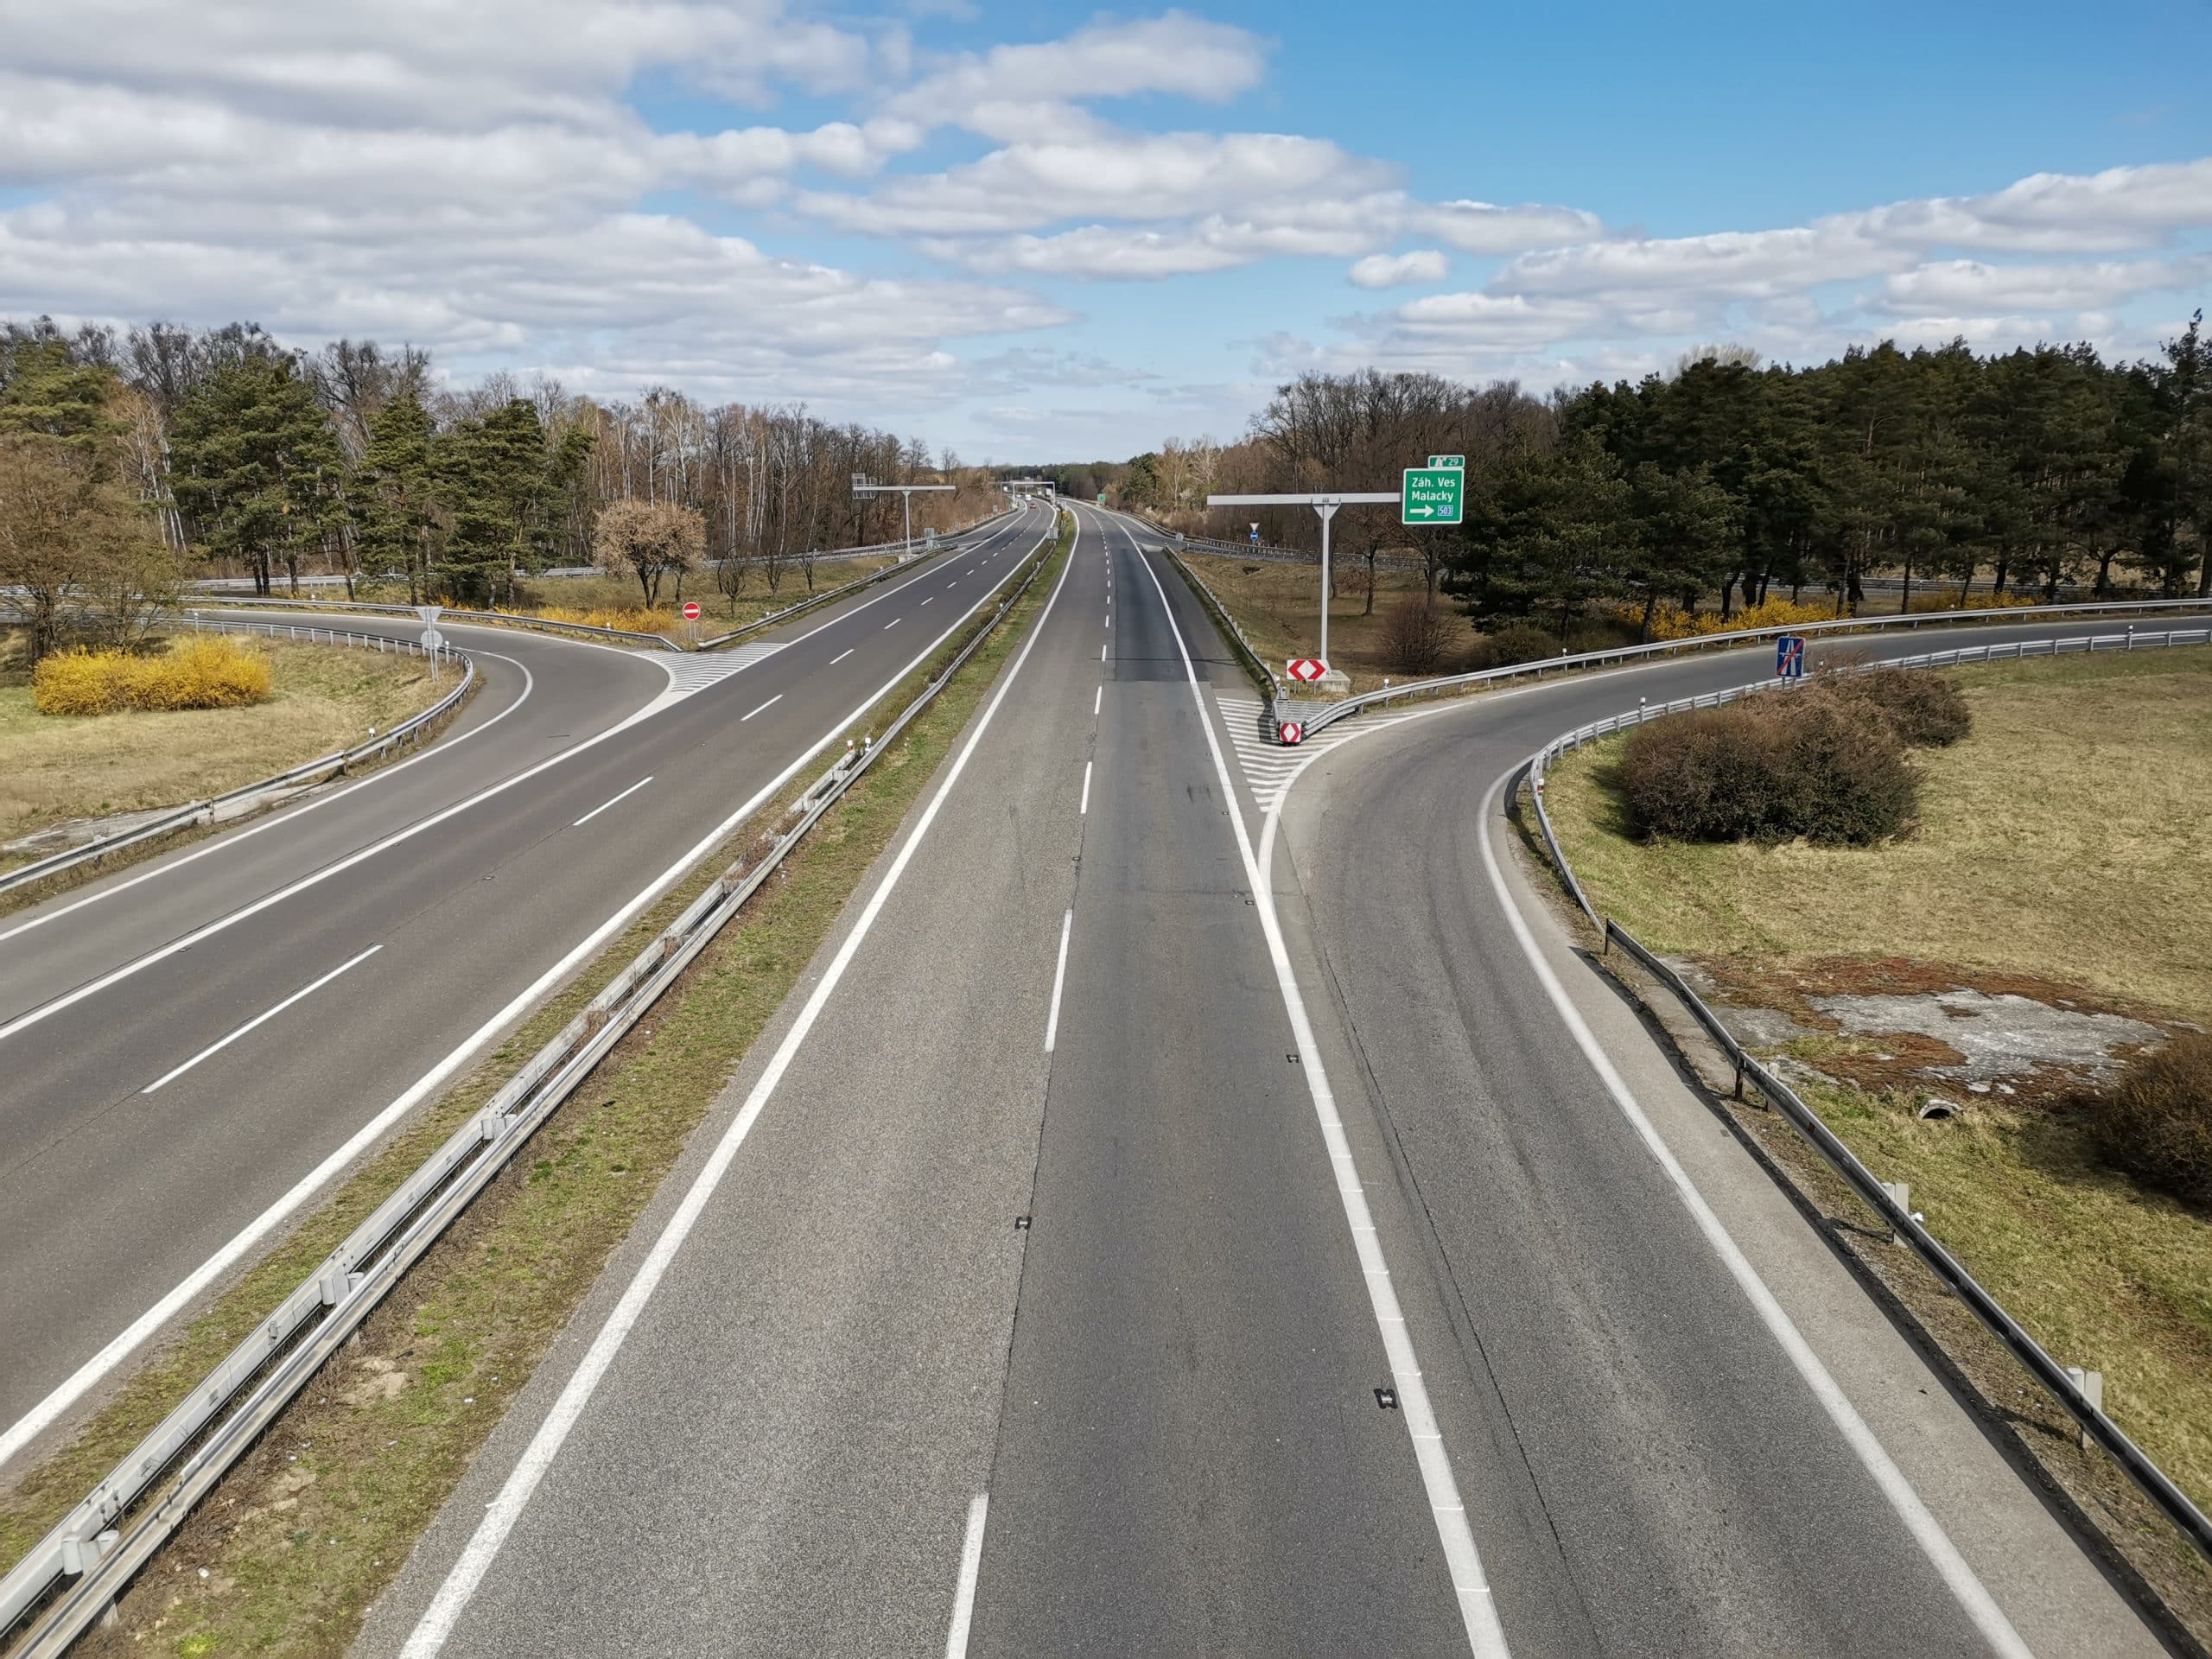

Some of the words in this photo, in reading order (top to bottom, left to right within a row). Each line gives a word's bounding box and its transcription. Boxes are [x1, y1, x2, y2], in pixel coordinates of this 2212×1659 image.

[1412, 477, 1434, 487] Záh.
[1437, 477, 1456, 487] Ves
[1411, 491, 1454, 503] Malacky
[1439, 505, 1452, 515] 503
